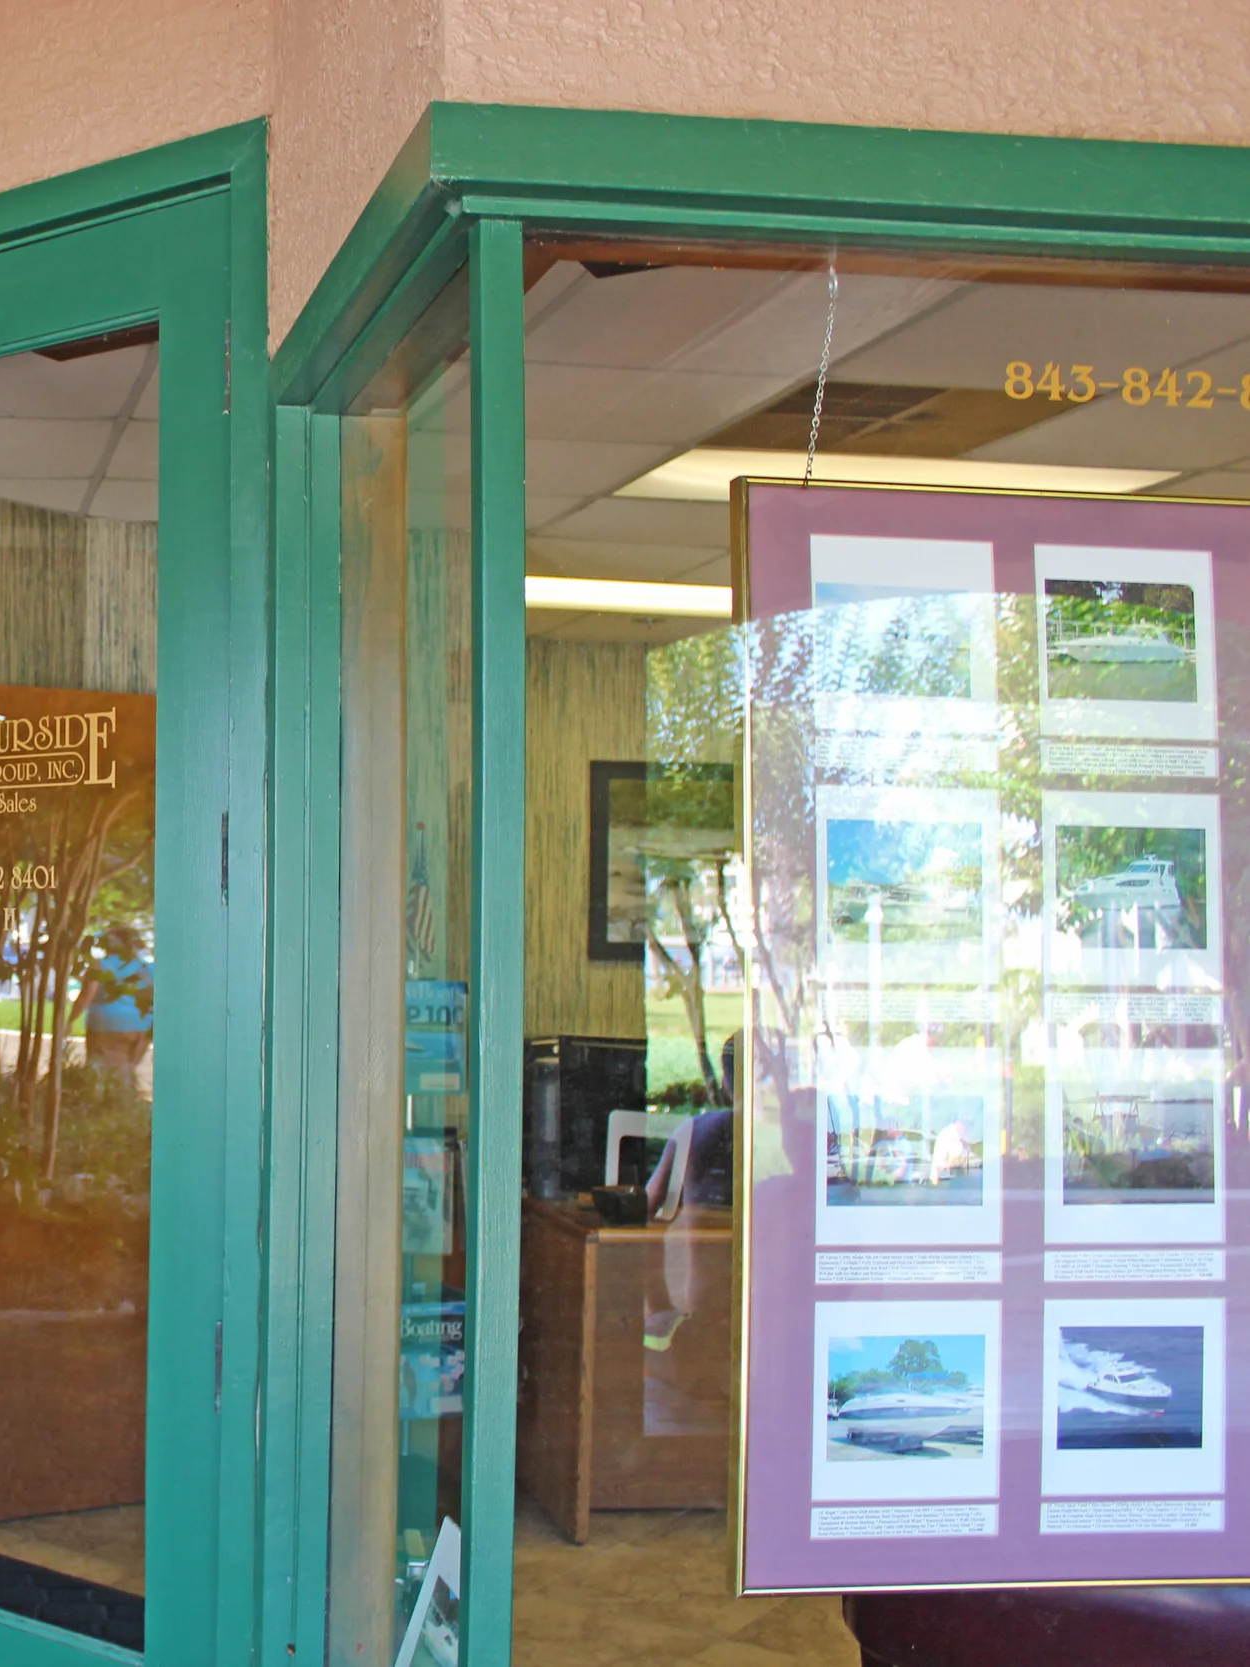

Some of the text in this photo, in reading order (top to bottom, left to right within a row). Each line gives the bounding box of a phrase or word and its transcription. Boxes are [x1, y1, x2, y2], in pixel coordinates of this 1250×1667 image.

[47, 760, 79, 780] INC.
[11, 865, 57, 891] 8401
[3, 908, 17, 931] H
